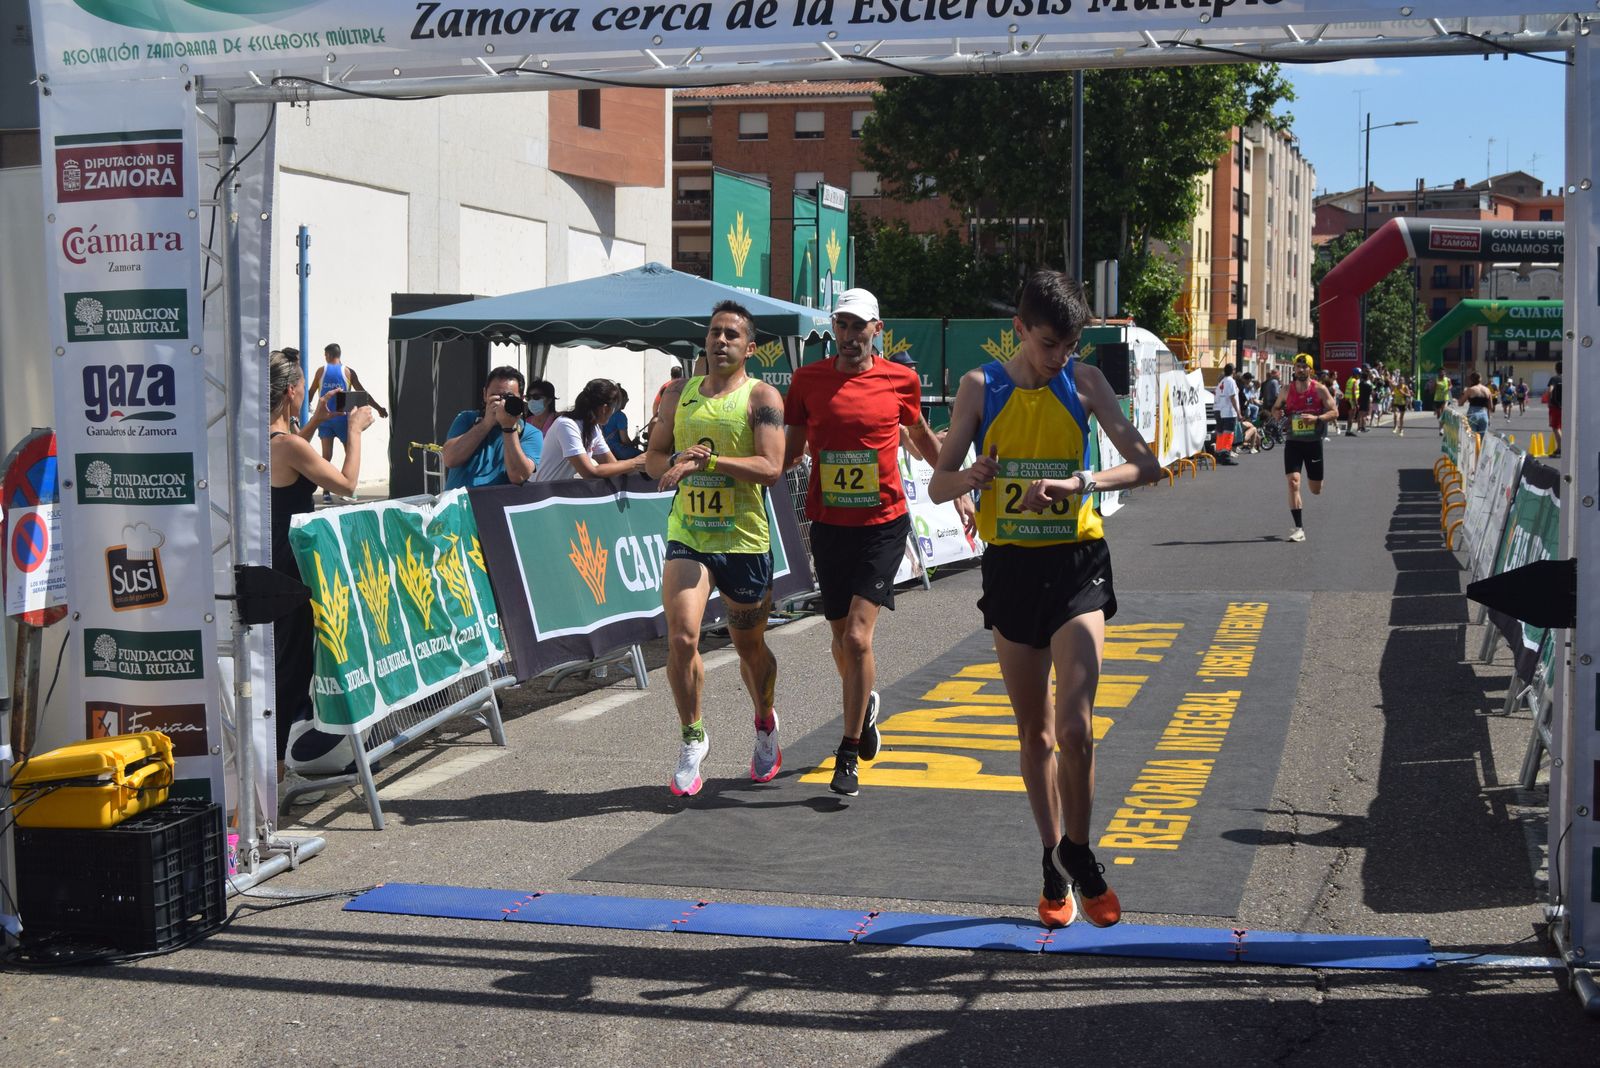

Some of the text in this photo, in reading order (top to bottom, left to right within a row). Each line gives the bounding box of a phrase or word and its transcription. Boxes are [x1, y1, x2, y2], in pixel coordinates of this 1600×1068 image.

[410, 2, 578, 39] Zamora
[592, 2, 710, 31] cerca
[726, 0, 778, 30] de
[793, 0, 833, 27] la
[848, 0, 1064, 24] Esclerosis
[63, 26, 386, 66] ASOCIACIÓN ZAMORANA DE ESCLEROSIS MÚLTIPLE
[84, 153, 175, 170] DIPUTACIÓN DE
[84, 167, 177, 190] ZAMORA
[1491, 228, 1565, 240] CON EL DEP
[1442, 239, 1478, 248] ZAMORA
[1491, 243, 1549, 254] GANAMOS
[108, 261, 141, 273] Zamora
[106, 308, 180, 322] FUNDACION
[1509, 307, 1564, 318] CAJA RU
[107, 321, 180, 336] CAJA RURAL
[1504, 328, 1562, 338] SALIDA
[82, 363, 176, 423] gaza
[86, 425, 177, 437] Ganaderos de Zamora
[1297, 420, 1310, 430] 8
[1020, 461, 1068, 471] FUNDACION
[113, 473, 186, 487] FUNDACION
[833, 467, 865, 490] 42
[1020, 470, 1041, 478] CAJA
[114, 486, 187, 500] CAJA RURAL
[687, 490, 724, 514] 114
[1018, 525, 1073, 534] CAJA RURAL
[112, 561, 158, 595] Susi
[118, 648, 195, 662] FUNDACION
[118, 661, 195, 675] CAJA RURAL
[1154, 690, 1242, 753] INTEGRAL
[1097, 758, 1217, 851] REFORMA
